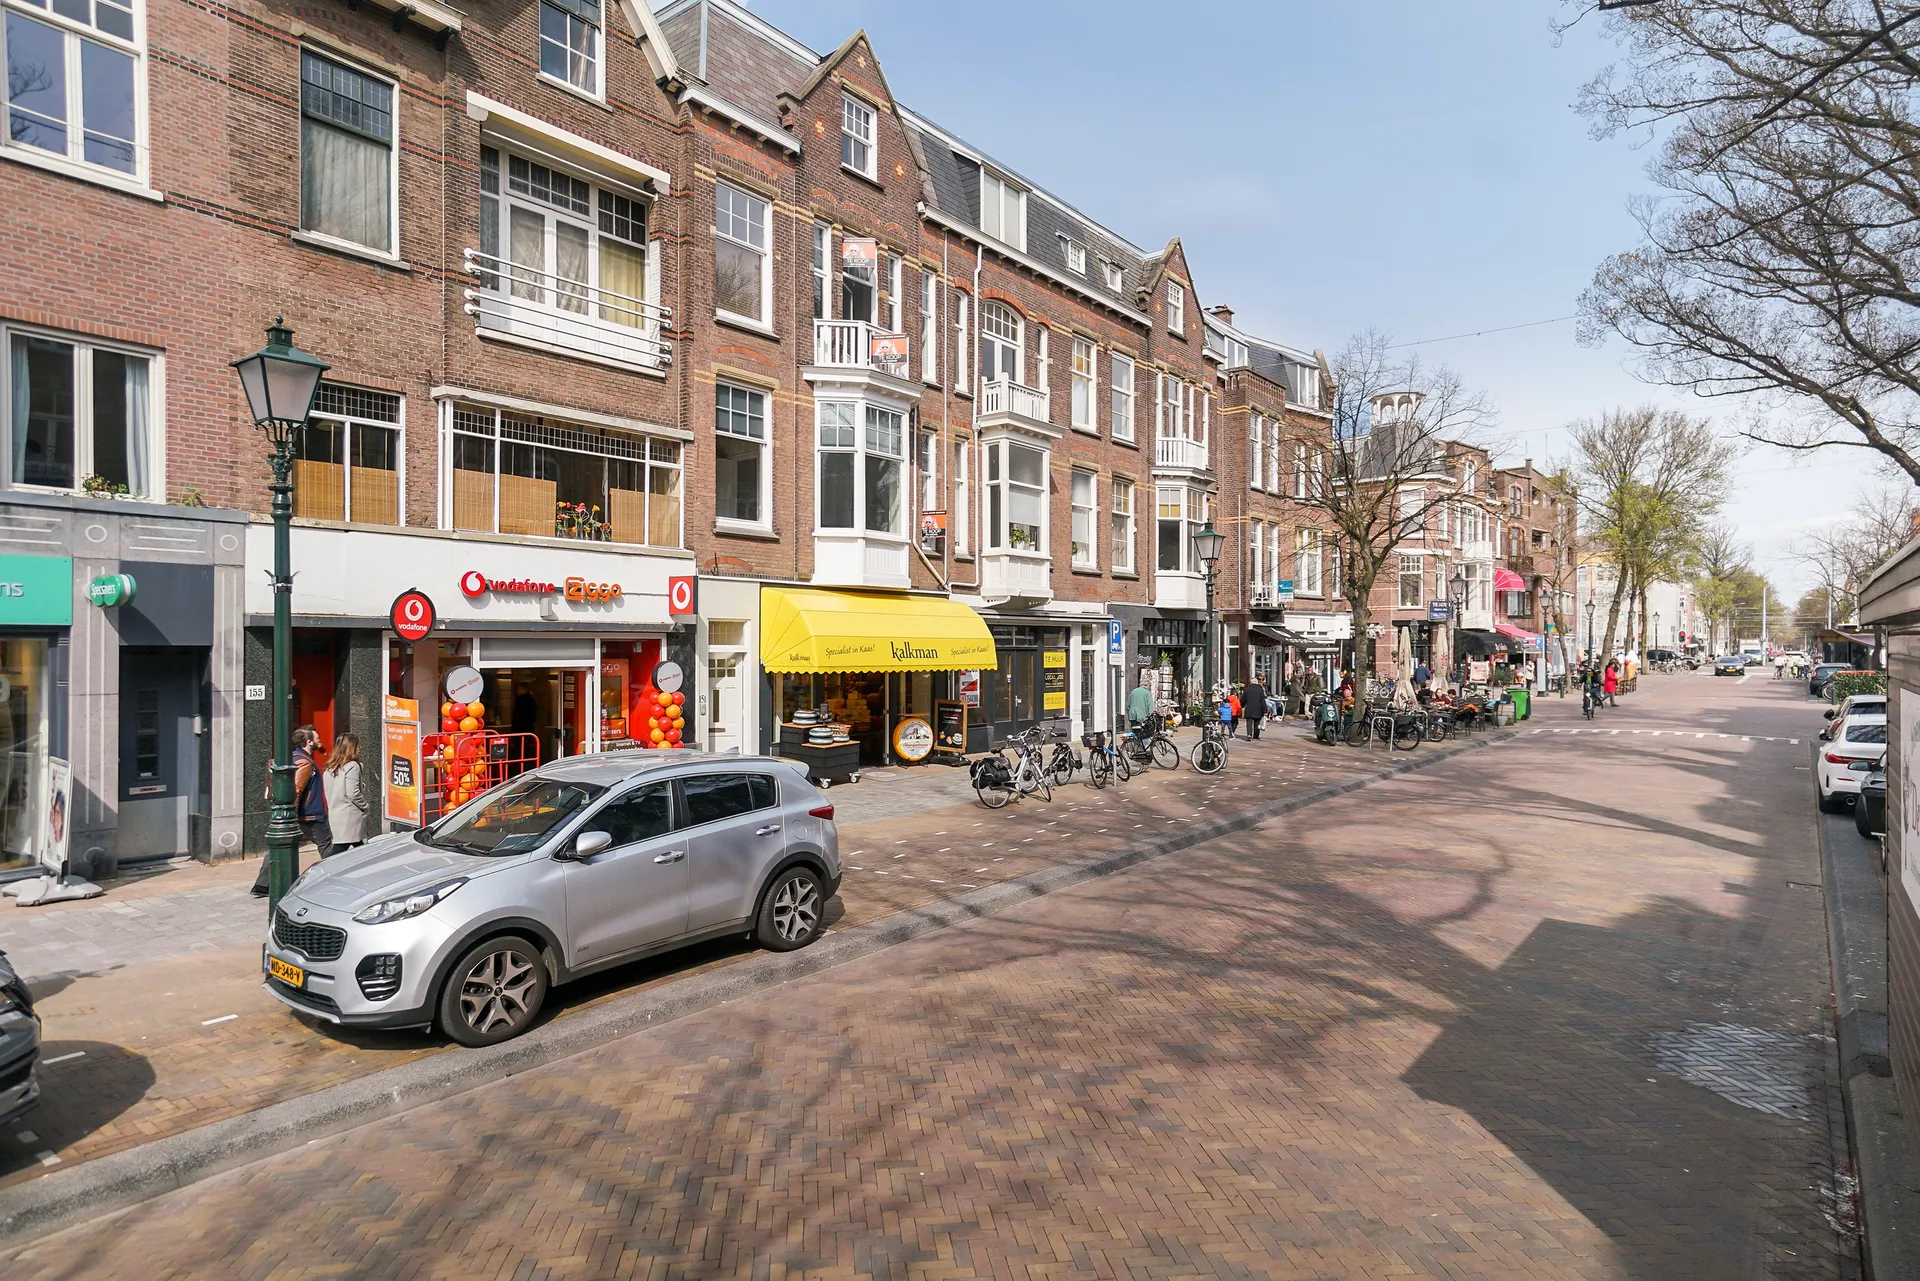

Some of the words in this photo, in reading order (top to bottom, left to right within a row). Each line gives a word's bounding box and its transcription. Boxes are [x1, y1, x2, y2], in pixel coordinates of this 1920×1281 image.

[91, 583, 116, 598] Specsavers
[489, 578, 555, 593] vodafone
[398, 624, 428, 632] vodafone
[1113, 623, 1119, 639] P
[789, 654, 811, 662] kalkman
[825, 645, 852, 659] Specialist
[859, 643, 875, 653] Kaas!
[890, 641, 939, 662] kalkman
[249, 688, 263, 697] 155
[394, 771, 410, 786] 50%
